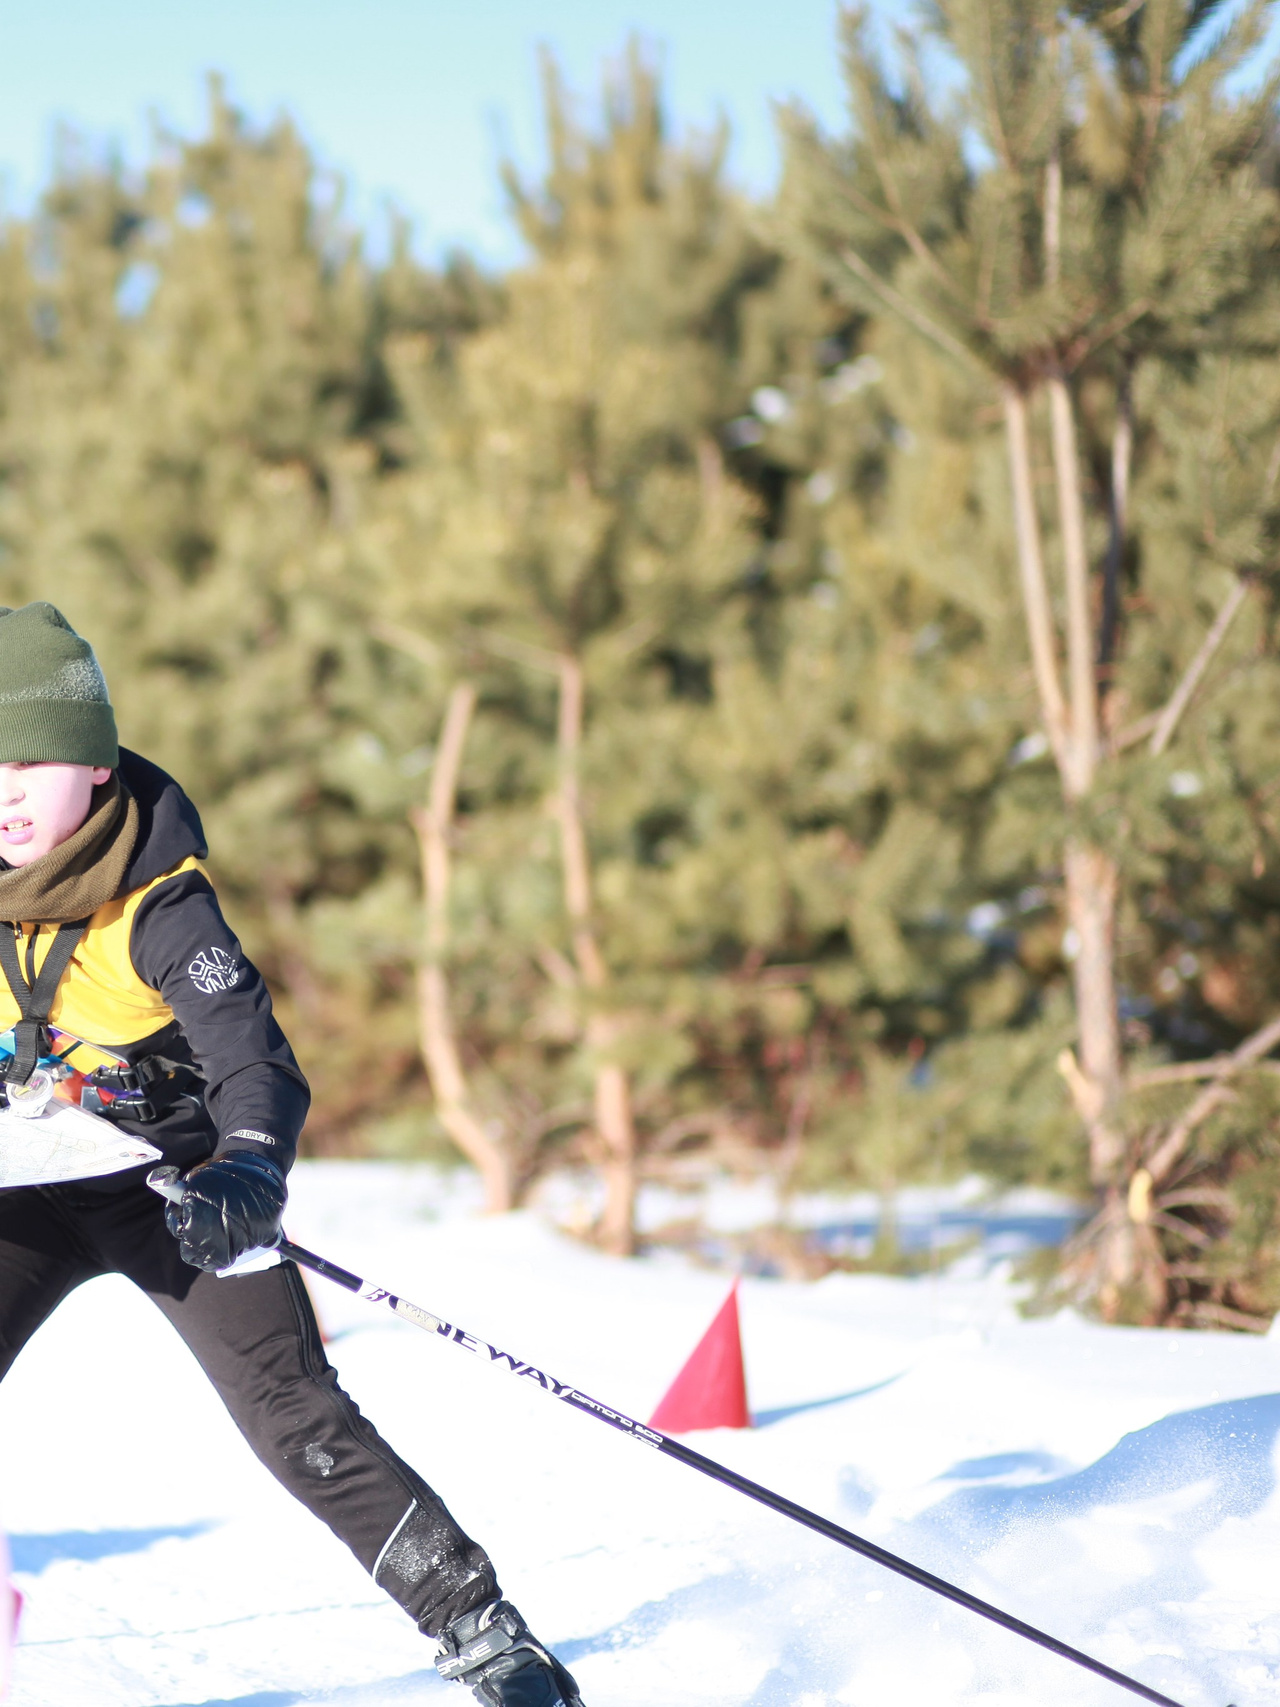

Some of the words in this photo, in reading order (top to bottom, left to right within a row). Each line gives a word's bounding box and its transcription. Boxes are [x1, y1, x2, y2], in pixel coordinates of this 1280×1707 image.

[246, 1131, 261, 1139] DRY
[571, 1392, 633, 1427] DIAMOND
[437, 1642, 491, 1675] SPINE
